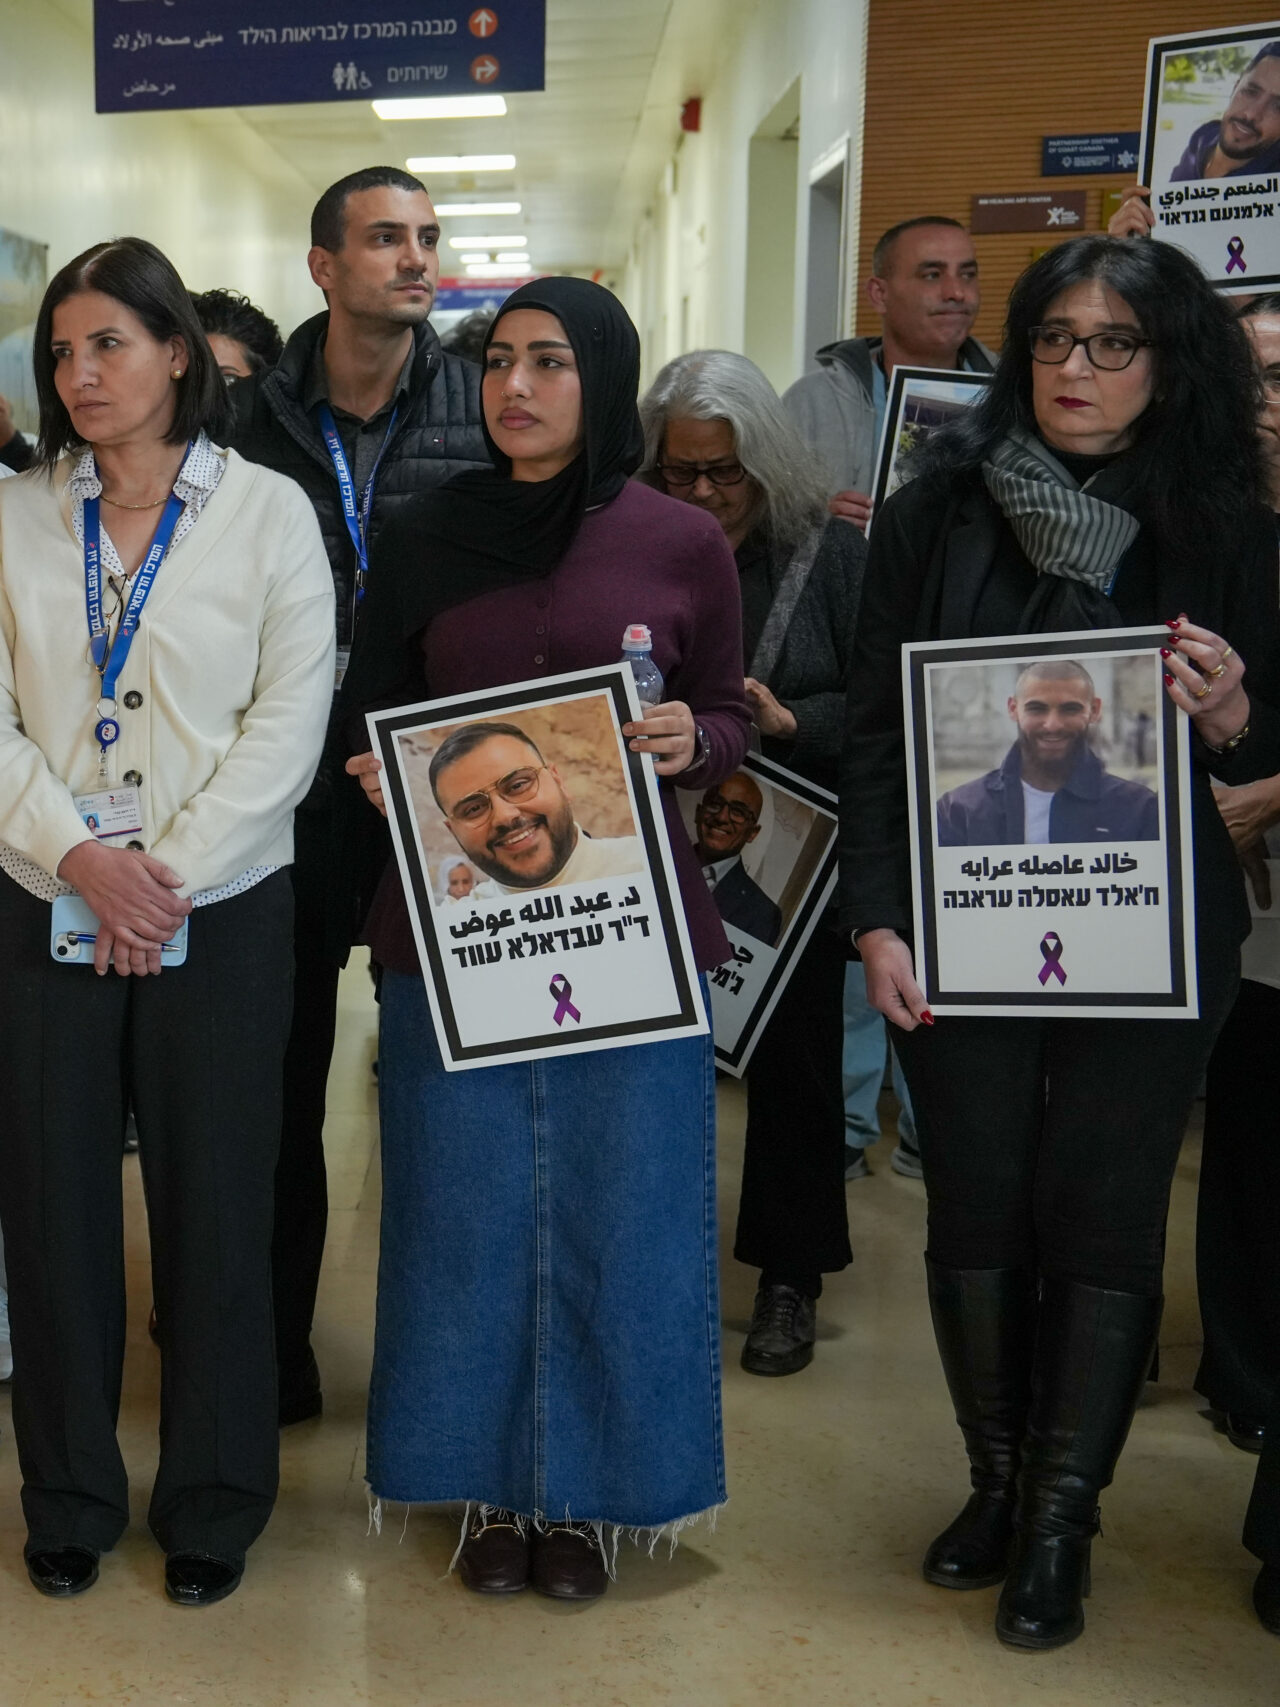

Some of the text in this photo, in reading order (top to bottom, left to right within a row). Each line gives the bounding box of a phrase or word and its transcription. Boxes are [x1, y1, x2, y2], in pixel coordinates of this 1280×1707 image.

[238, 18, 458, 45] מבנה המרכז לבריאות הילד
[387, 65, 449, 82] שירותים
[1159, 186, 1220, 210] جنداوي
[1159, 201, 1274, 226] אלמנעם גנדאוי
[333, 450, 350, 482] הרפואי
[343, 485, 356, 517] המרכז
[88, 565, 99, 601] הרפואי
[123, 543, 163, 627] המרכז הרפואי זיו
[960, 852, 1138, 881] خالد عاصله عرابه
[519, 894, 564, 923] الله
[570, 891, 612, 919] عبد
[943, 884, 1159, 908] ח'אלד עאסלה עראבה
[449, 908, 515, 939] عوض
[451, 915, 651, 968] ד"ר עבדאלא עווד
